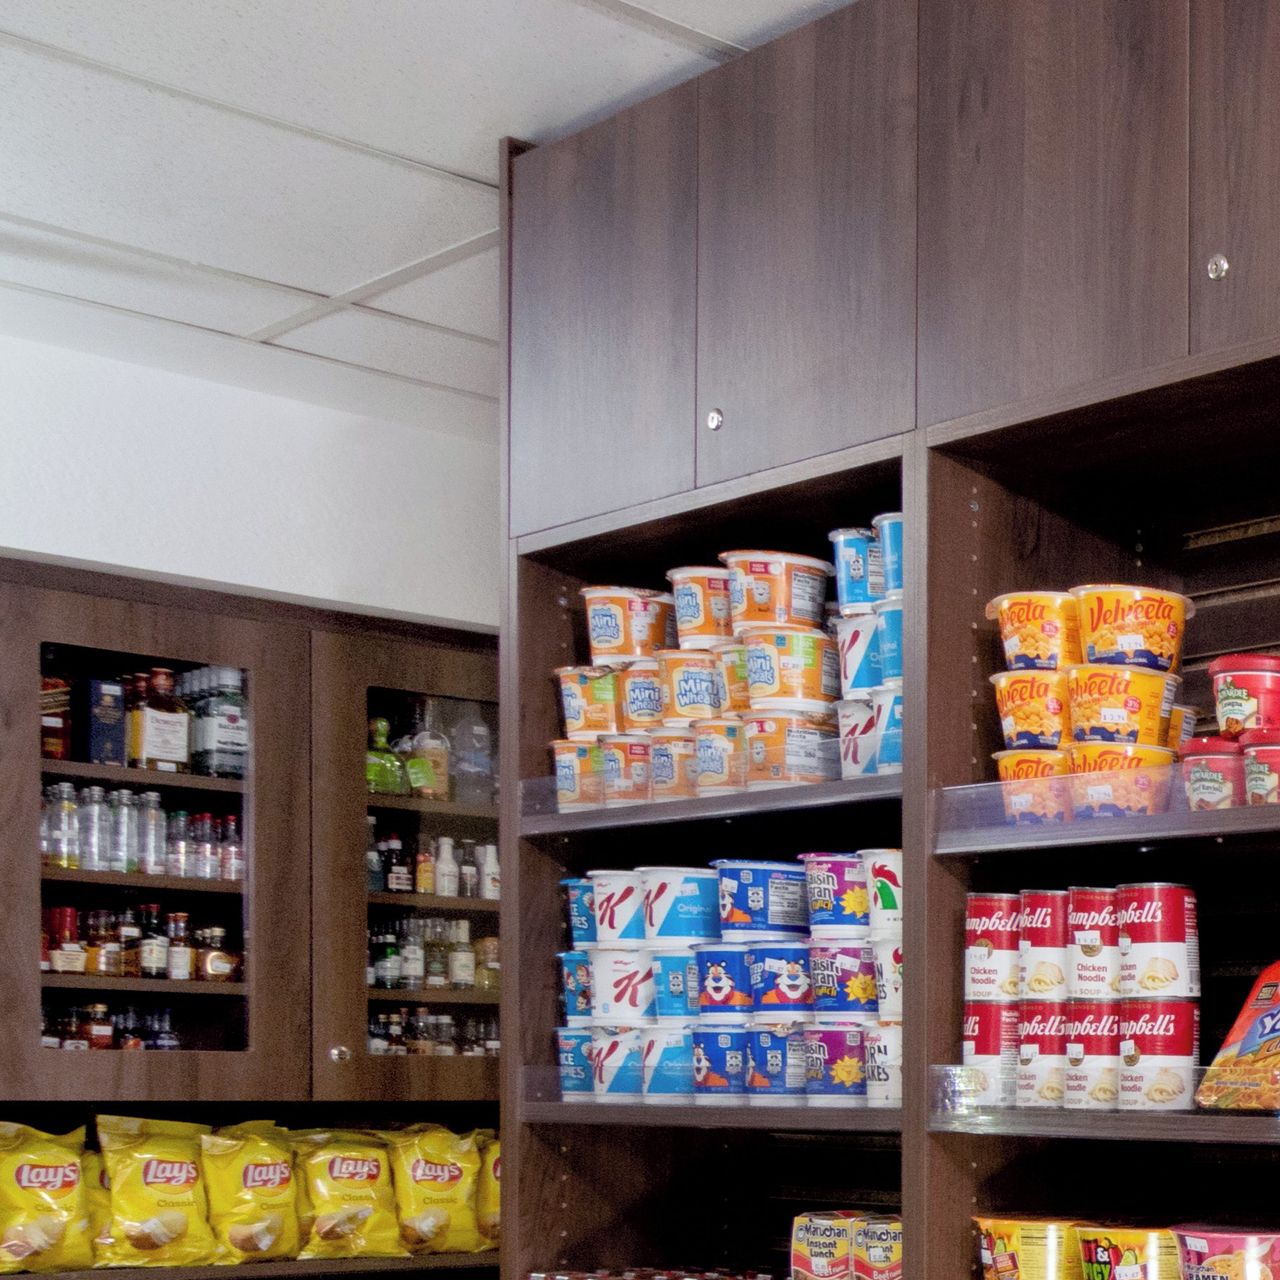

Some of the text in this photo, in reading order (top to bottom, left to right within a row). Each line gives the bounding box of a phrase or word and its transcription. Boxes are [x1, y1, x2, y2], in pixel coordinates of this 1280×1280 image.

[1090, 597, 1174, 633] Velveeta
[971, 967, 998, 976] Chicken
[1077, 963, 1108, 973] Chicken
[971, 977, 997, 986] Noodle
[1077, 973, 1106, 984] Noodle
[807, 1239, 837, 1249] Instant
[810, 1249, 835, 1258] Lunch
